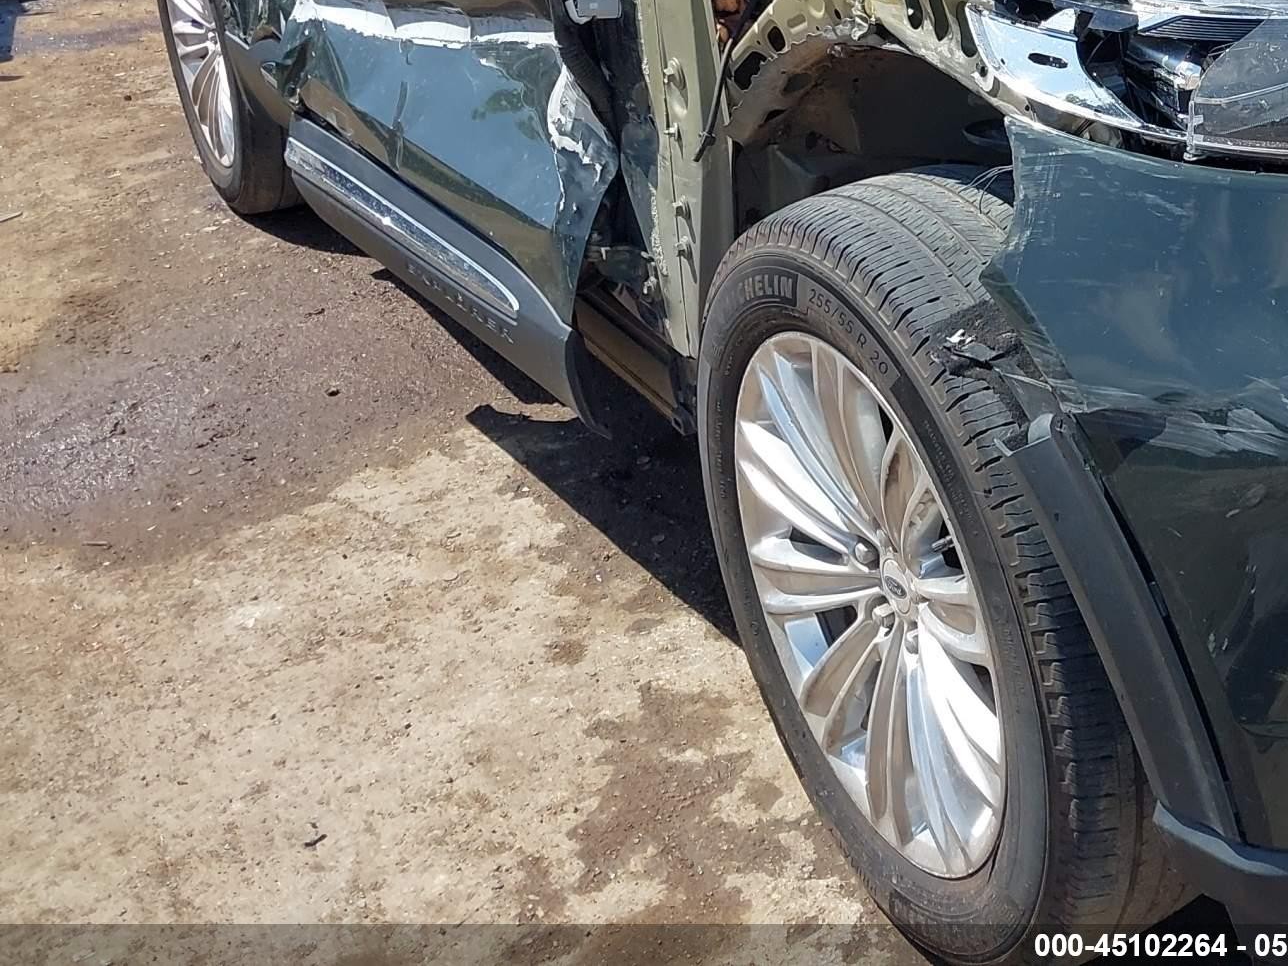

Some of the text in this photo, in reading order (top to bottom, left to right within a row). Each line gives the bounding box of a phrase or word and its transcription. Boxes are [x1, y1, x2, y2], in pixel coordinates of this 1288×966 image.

[718, 273, 793, 309] ICHELIN
[808, 288, 889, 375] 255/55 R 20
